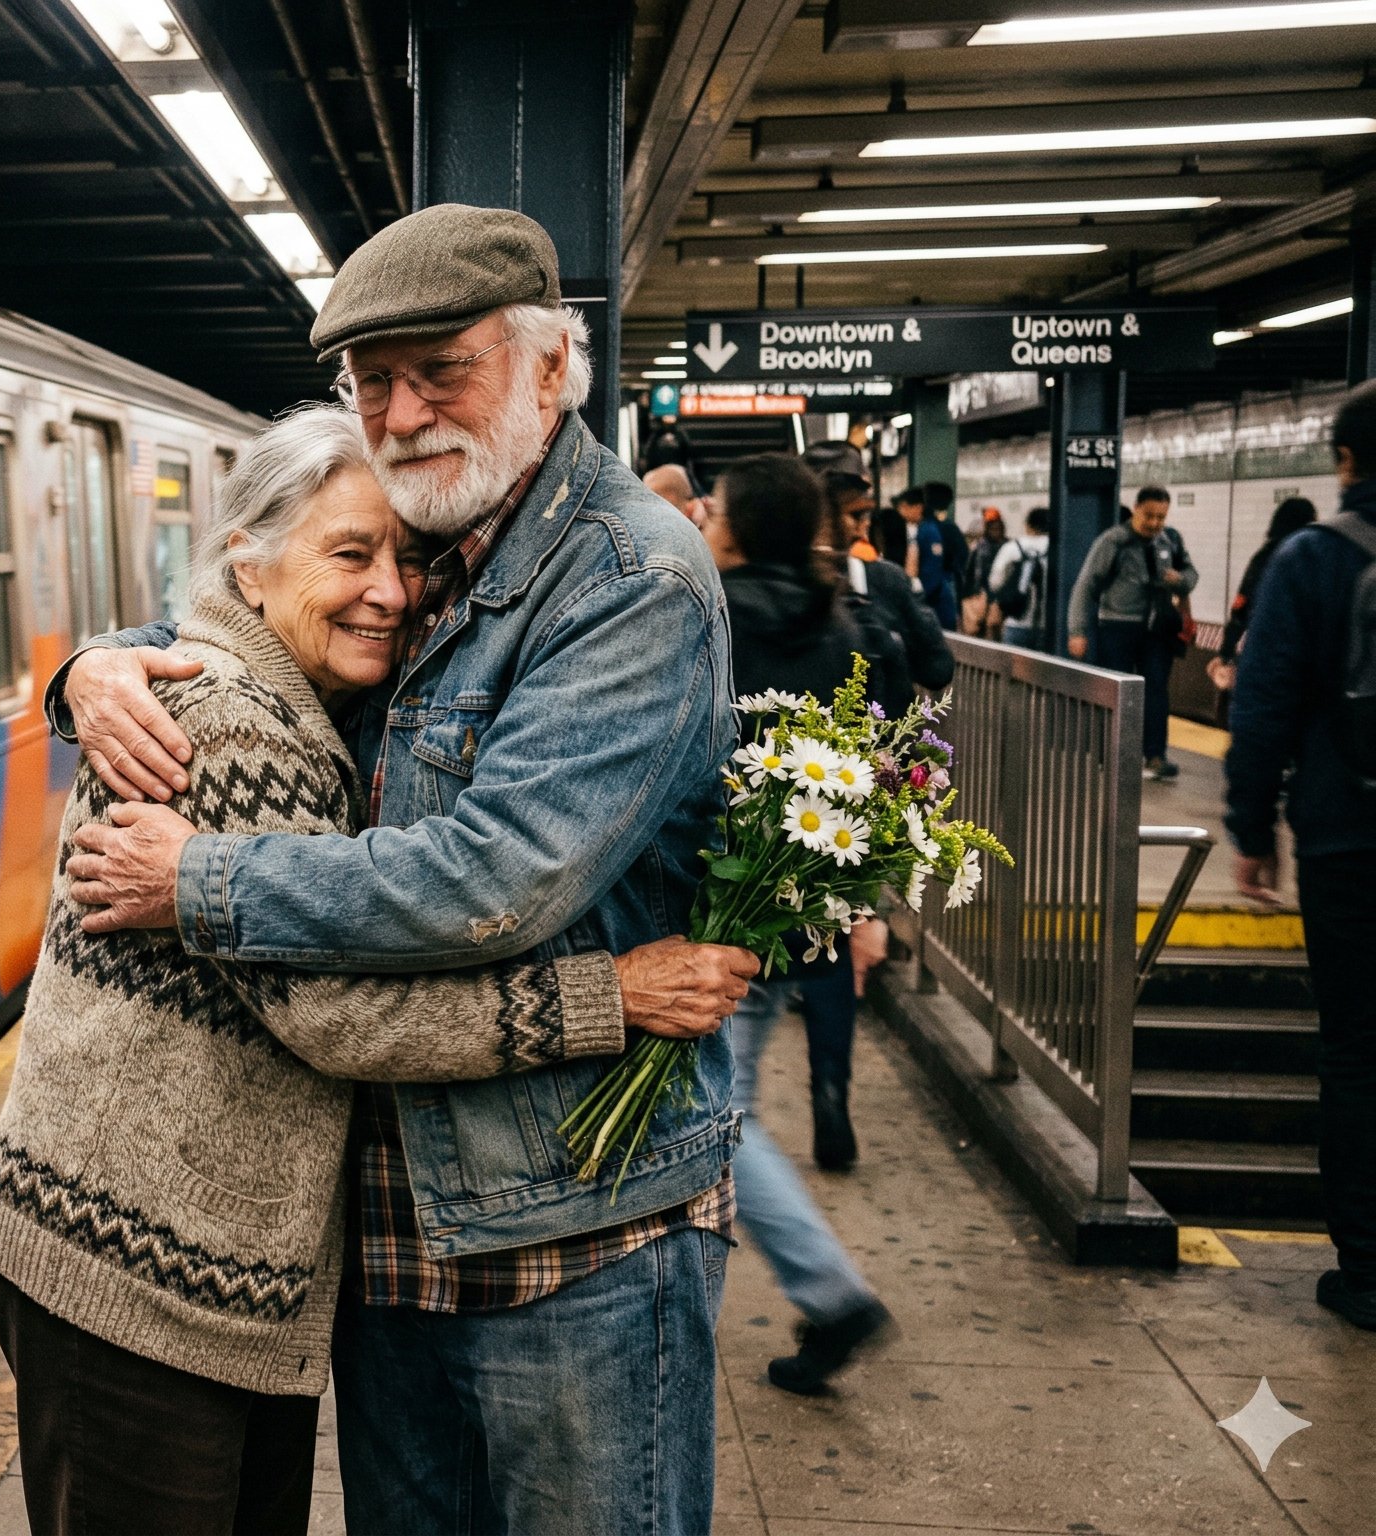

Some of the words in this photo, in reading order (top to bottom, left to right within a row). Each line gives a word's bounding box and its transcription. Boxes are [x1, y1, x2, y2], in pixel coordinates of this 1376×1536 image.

[760, 321, 894, 344] Downtown
[901, 317, 921, 342] &
[1012, 315, 1112, 342] Uptown
[1120, 313, 1140, 336] &
[759, 345, 873, 373] Brooklyn
[1011, 340, 1113, 365] Queens
[1066, 438, 1090, 457] 42
[1094, 438, 1114, 456] St
